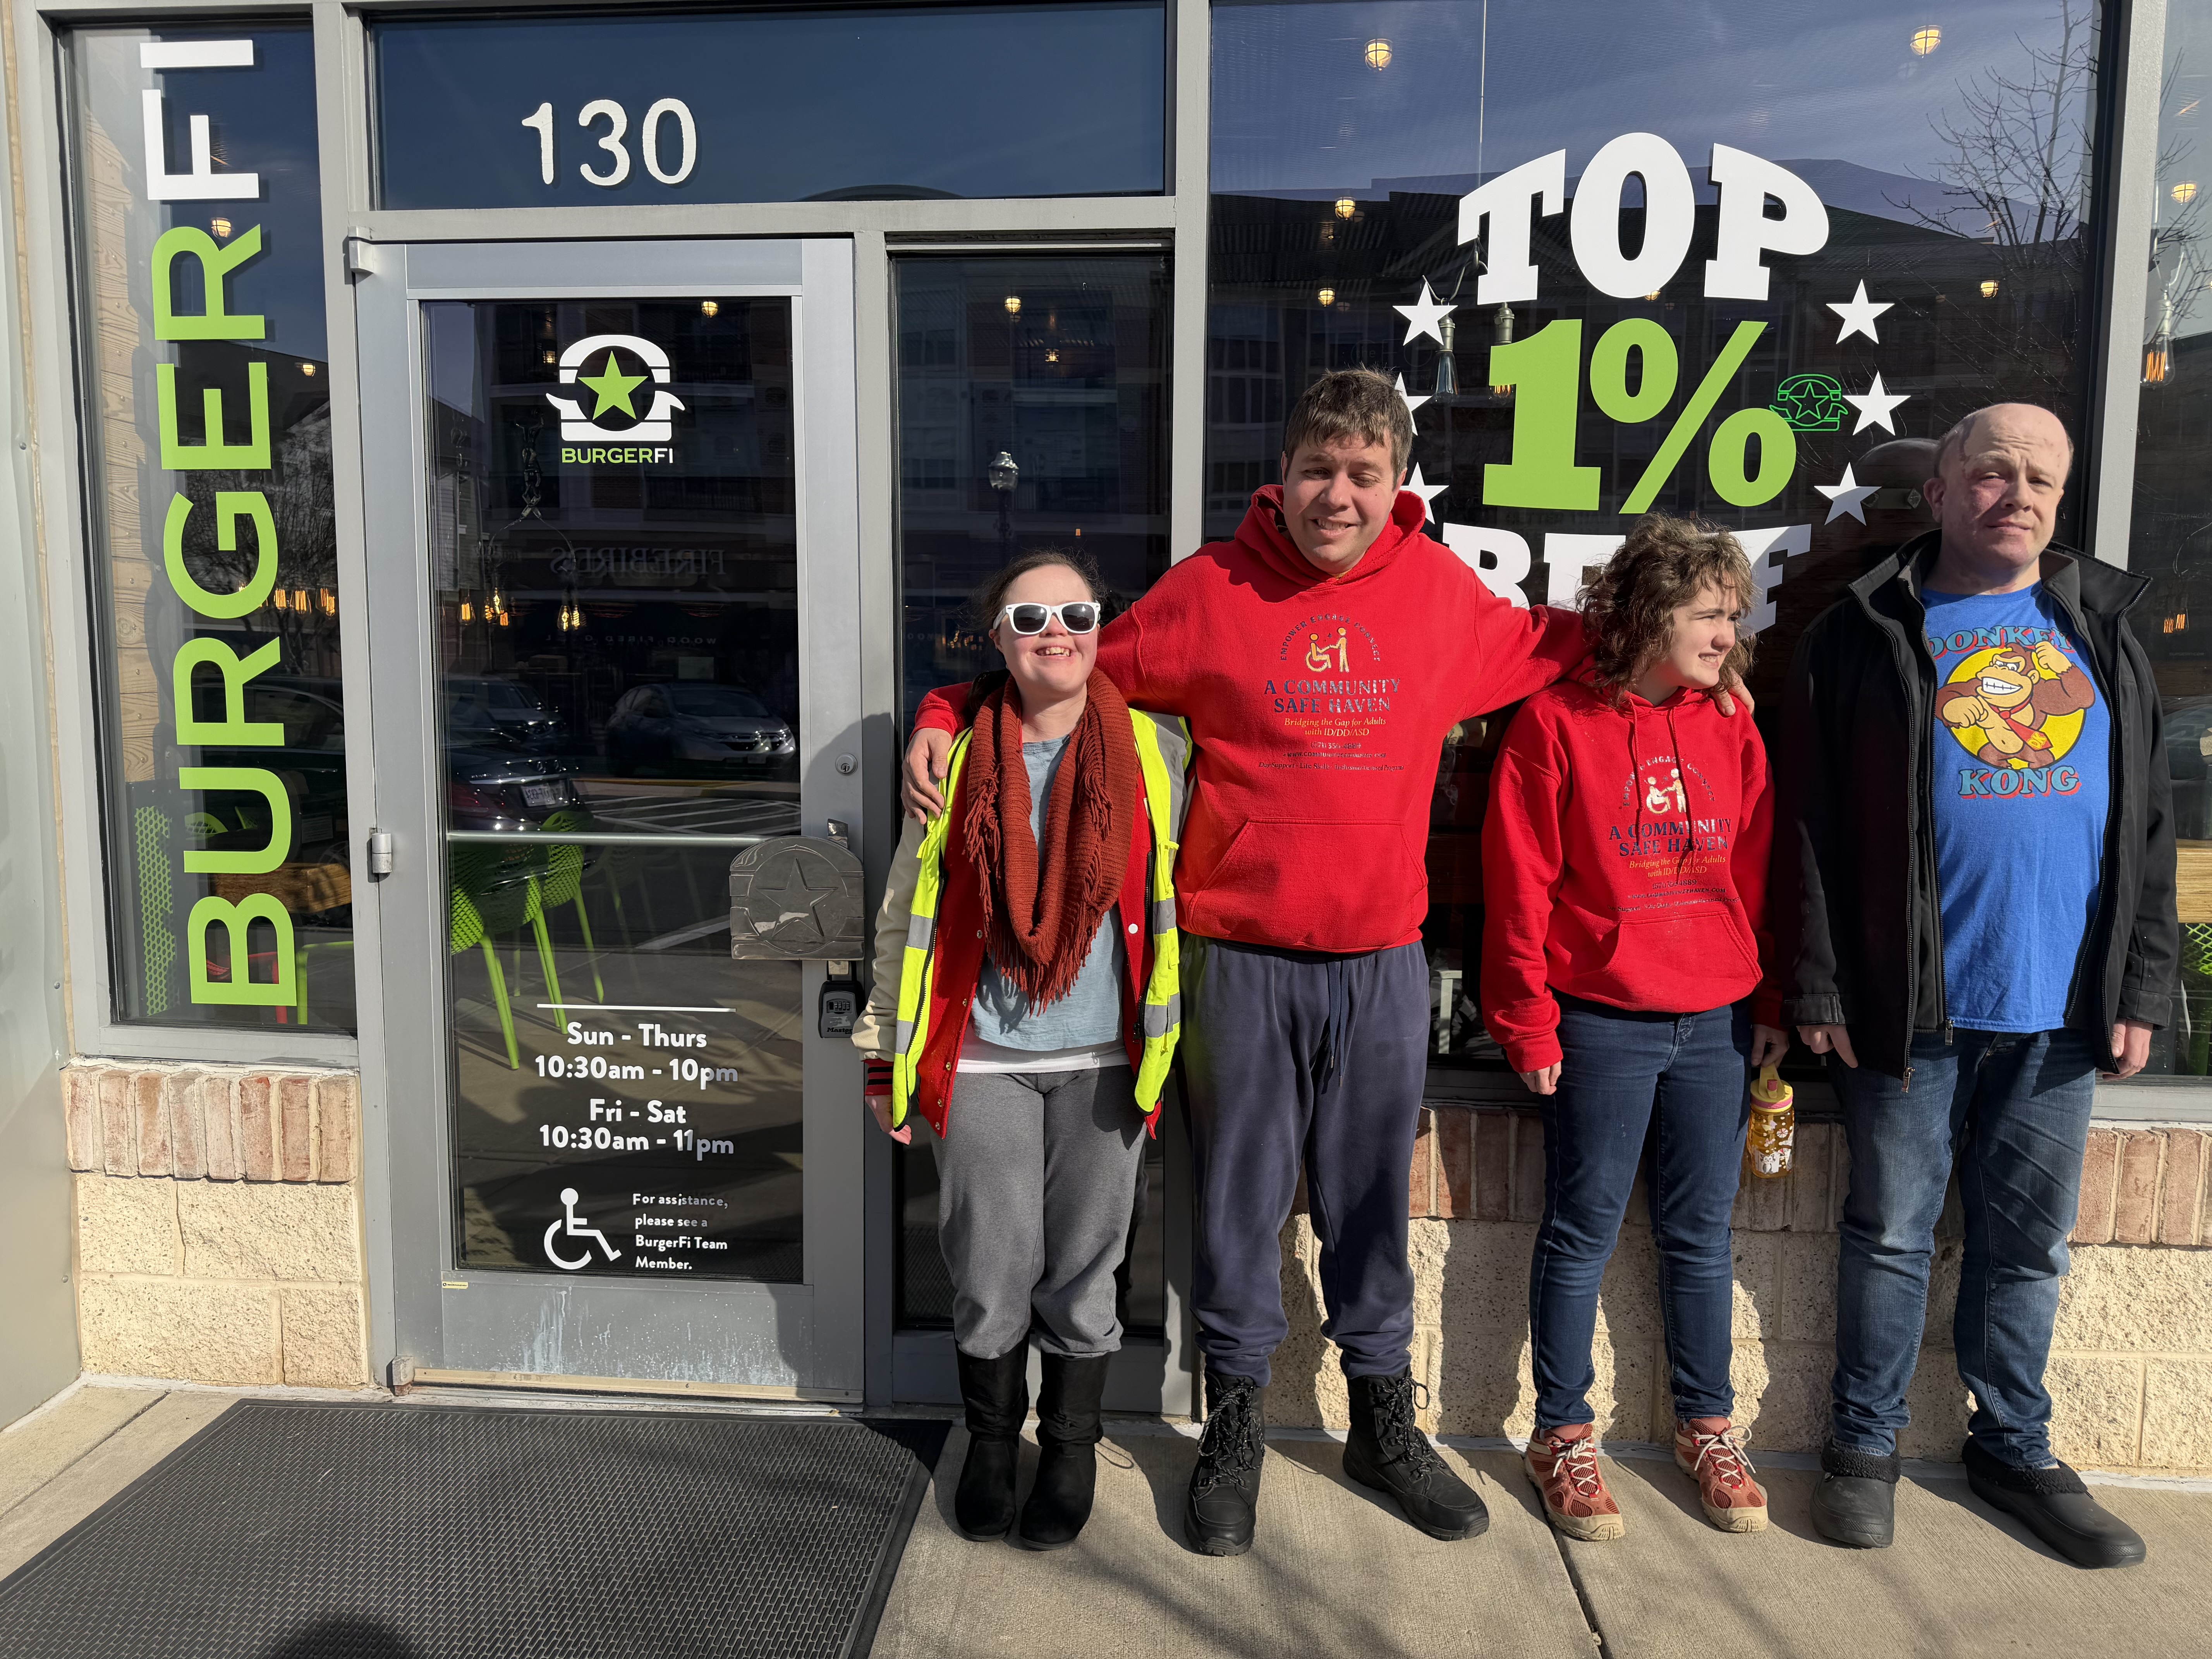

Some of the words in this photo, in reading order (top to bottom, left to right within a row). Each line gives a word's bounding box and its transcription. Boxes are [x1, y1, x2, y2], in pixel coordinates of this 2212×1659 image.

[522, 98, 697, 186] 130
[1458, 132, 1829, 305] TOP
[1482, 318, 1797, 514] 1%
[562, 448, 673, 464] BURGERFI
[140, 39, 297, 1007] BURGERFI
[1443, 523, 1812, 635] BEF
[1280, 621, 1308, 661] EMPOWER
[1264, 680, 1277, 694] A
[1283, 678, 1401, 695] COMMUNITY
[1274, 698, 1321, 713] SAFE
[1328, 697, 1390, 713] HAVEN
[1284, 718, 1319, 727] Bridging
[1334, 718, 1350, 728] Gap
[1350, 718, 1362, 728] for
[1364, 716, 1386, 725] Adults
[1324, 728, 1370, 736] ID/DD/ASD
[2026, 731, 2047, 750] DK
[1958, 765, 2081, 799] KONG
[1608, 825, 1622, 840] A
[1619, 839, 1661, 857] SAFE
[1629, 859, 1660, 869] Bridging
[1660, 857, 1670, 865] the
[1702, 854, 1726, 863] Adults
[1647, 869, 1662, 877] with
[567, 1022, 613, 1045] Sun
[638, 1023, 707, 1048] Thurs
[535, 1055, 644, 1080] 10:30am
[669, 1058, 738, 1090] 10pm
[590, 1098, 622, 1121] Fri
[647, 1100, 686, 1123] Sat
[540, 1125, 649, 1151] 10:30am
[673, 1129, 734, 1161] 11pm
[632, 1193, 655, 1205] For
[658, 1193, 728, 1209] assistance,
[635, 1213, 674, 1230] please
[677, 1219, 698, 1227] see
[701, 1219, 708, 1228] a
[635, 1234, 691, 1252] BurgerFi
[694, 1236, 728, 1250] Team
[635, 1255, 692, 1270] Member.
